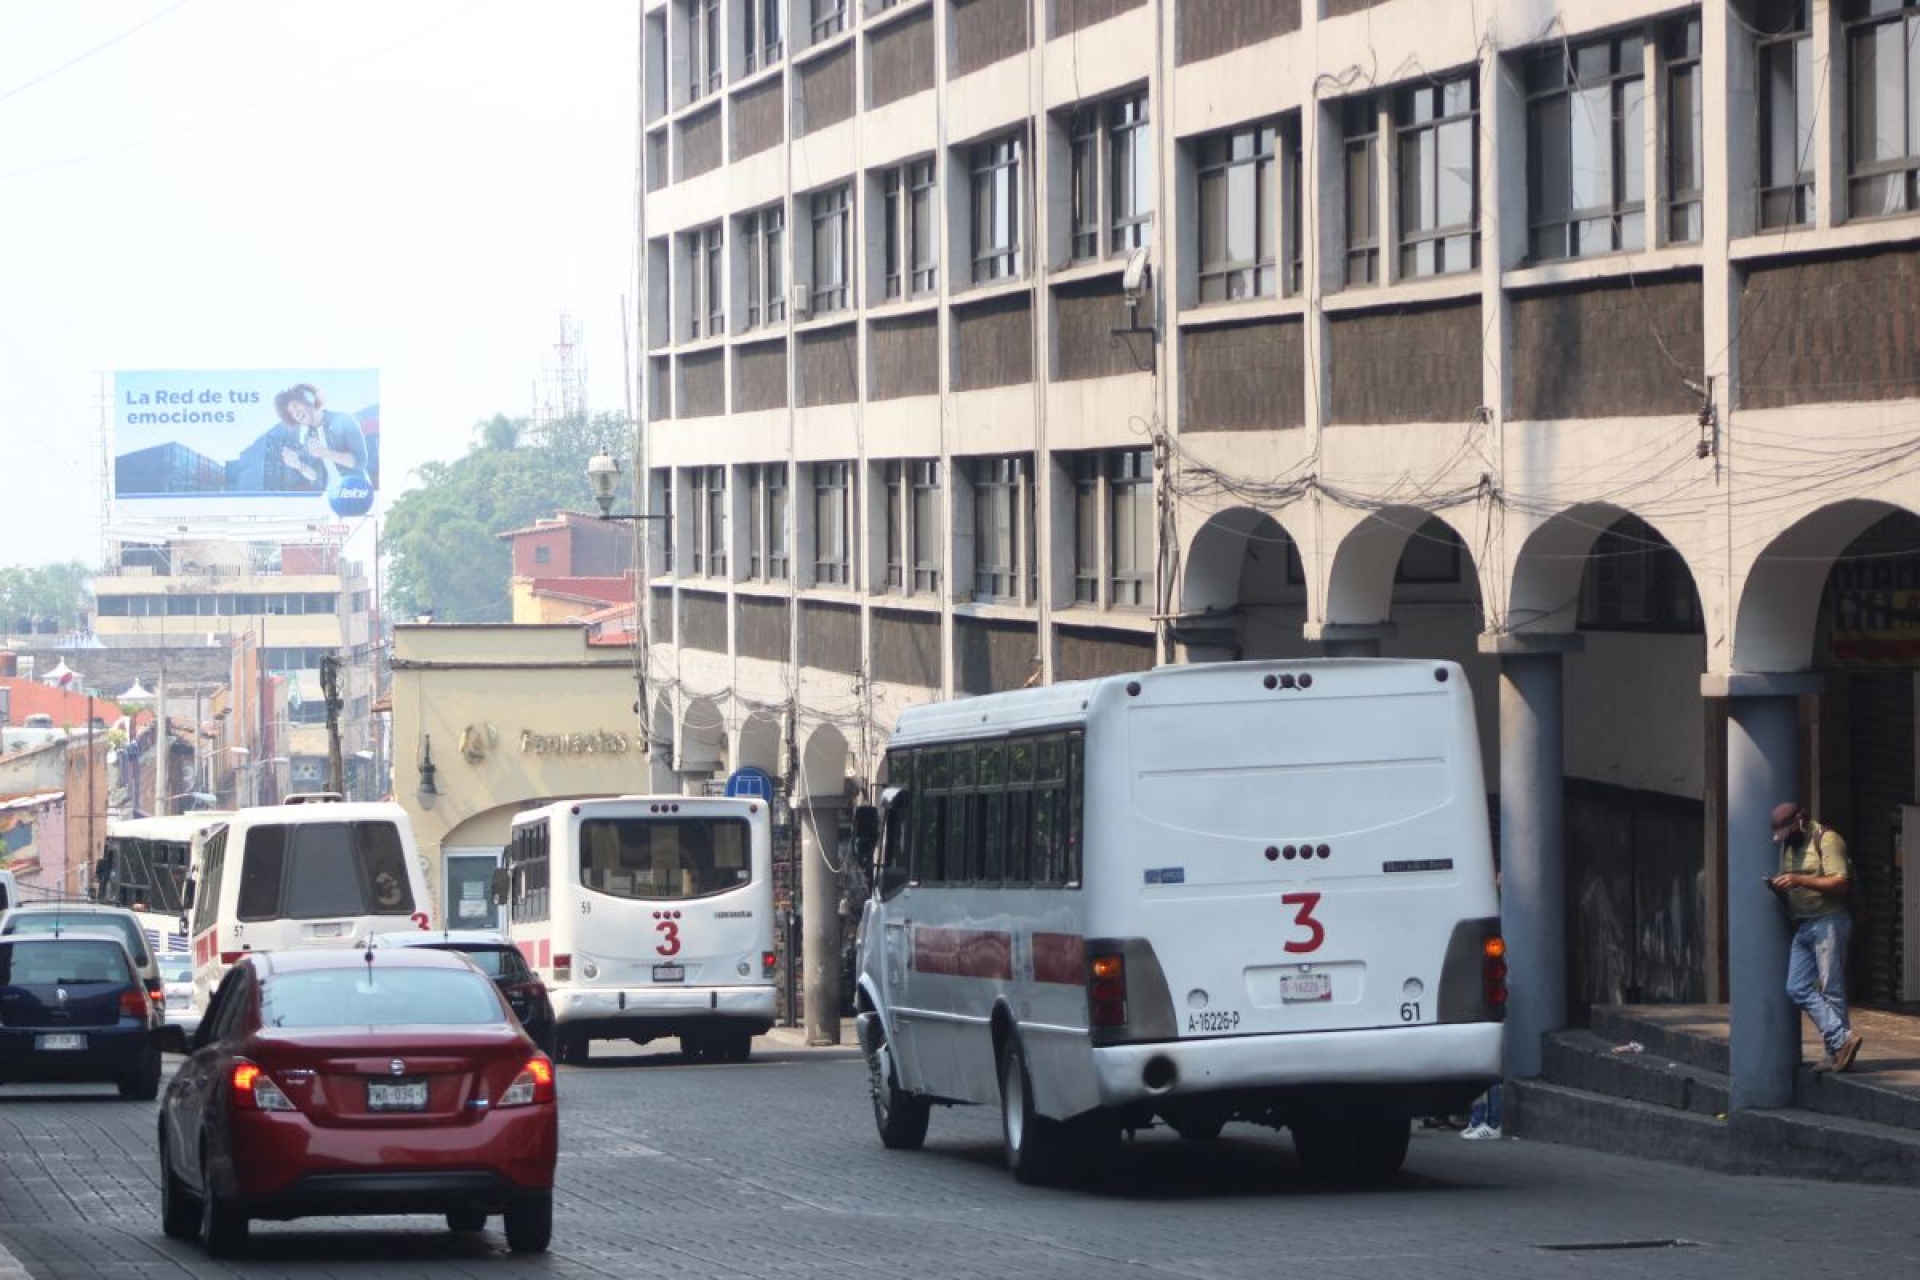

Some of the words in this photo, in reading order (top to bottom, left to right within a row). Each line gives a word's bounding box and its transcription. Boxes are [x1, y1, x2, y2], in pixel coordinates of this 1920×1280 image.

[126, 390, 149, 405] La
[155, 389, 193, 404] Red
[199, 389, 222, 404] de
[229, 389, 259, 404] tus
[127, 409, 236, 424] emociones
[1281, 892, 1325, 953] 3
[656, 921, 681, 956] 3
[1401, 1002, 1421, 1022] 61
